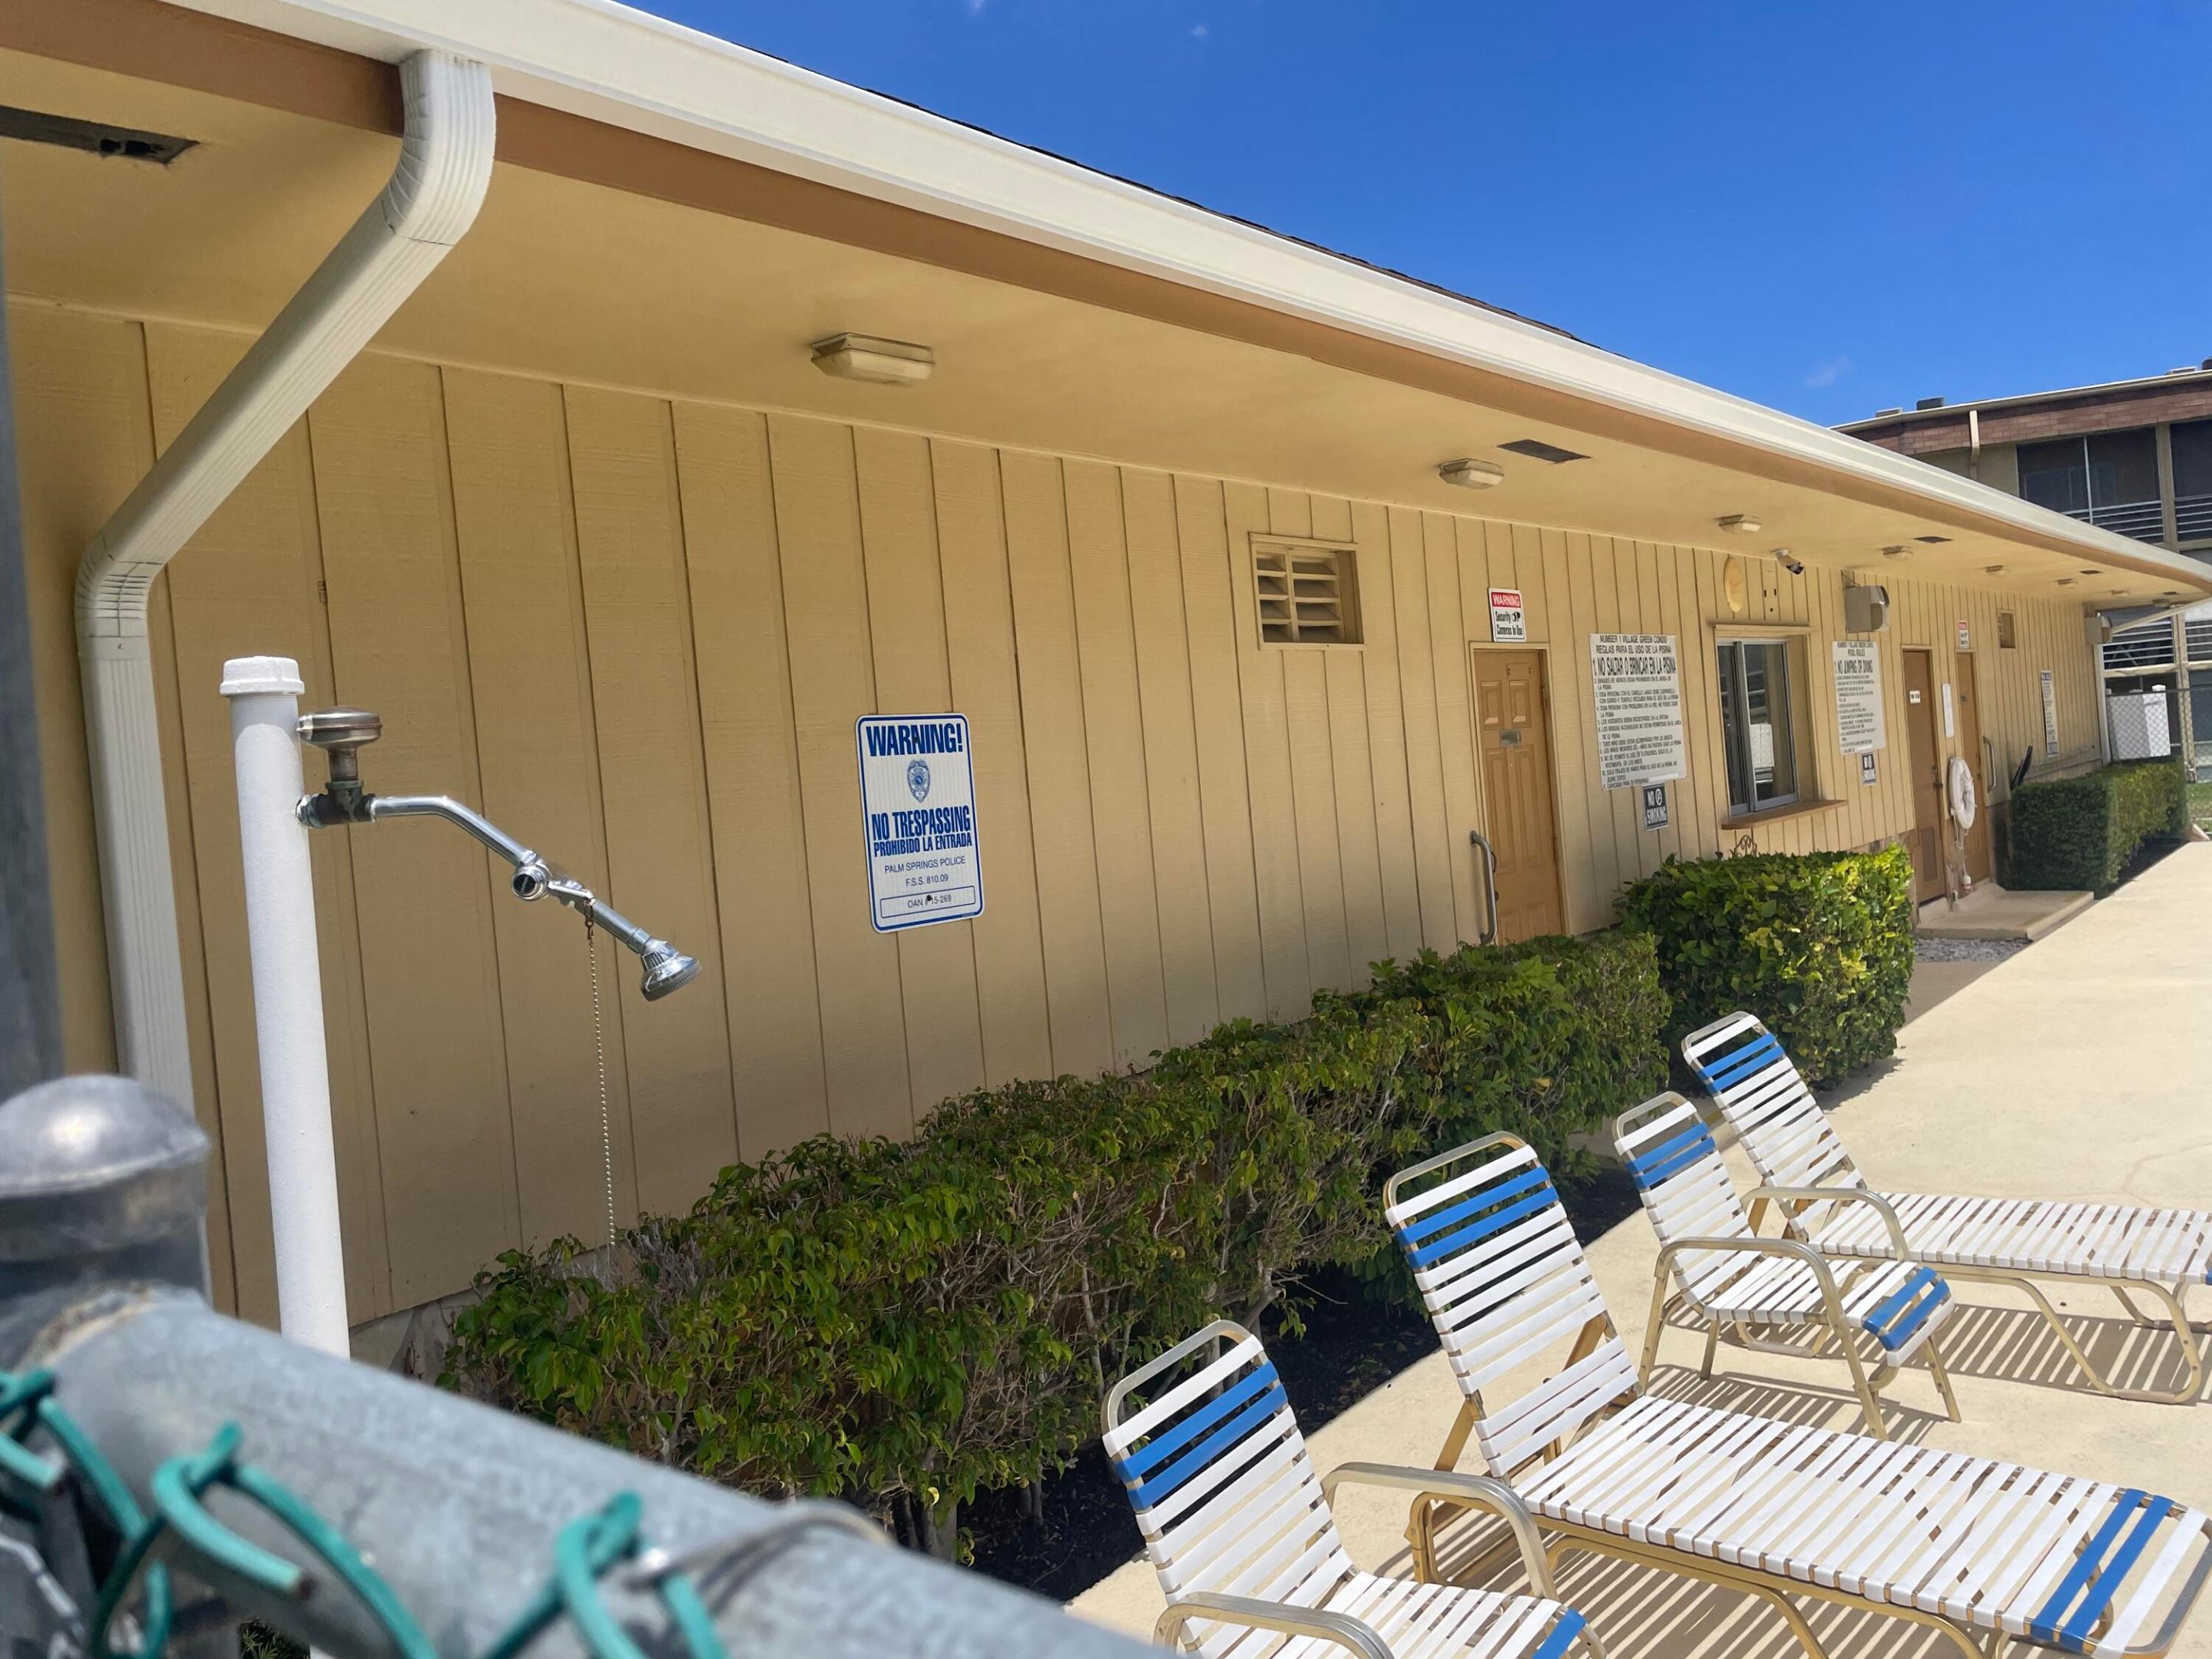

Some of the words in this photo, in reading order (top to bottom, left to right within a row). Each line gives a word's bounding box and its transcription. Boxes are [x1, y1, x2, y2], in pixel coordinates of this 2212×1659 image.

[1492, 594, 1520, 606] WARNING
[1495, 611, 1511, 624] Security
[1497, 624, 1512, 635] Cameras
[1596, 645, 1614, 654] REGLAS
[1616, 645, 1627, 654] PARA
[1628, 645, 1634, 654] EL
[1635, 645, 1644, 654] USO
[1645, 645, 1651, 654] DE
[1598, 657, 1605, 676] NO
[1607, 657, 1622, 676] SALTAR
[1624, 657, 1628, 675] O
[1630, 657, 1648, 675] BRINCAR
[1650, 657, 1656, 674] EN
[1657, 657, 1662, 674] LA
[1838, 660, 1843, 674] NO
[866, 723, 963, 757] WARNING!
[1647, 790, 1654, 806] NO
[1647, 806, 1667, 824] SMOKING
[871, 813, 890, 840] NO
[892, 806, 971, 837] TRESPASSING
[874, 838, 920, 857] PROHIBIDO
[922, 837, 933, 852] LA
[935, 833, 972, 851] ENTRADA
[884, 865, 905, 873] PALM
[906, 860, 938, 871] SPRINGS
[940, 856, 965, 866] POLICE
[906, 877, 925, 886] F.S.S.
[926, 875, 949, 885] 810.09
[907, 899, 922, 908] OAN
